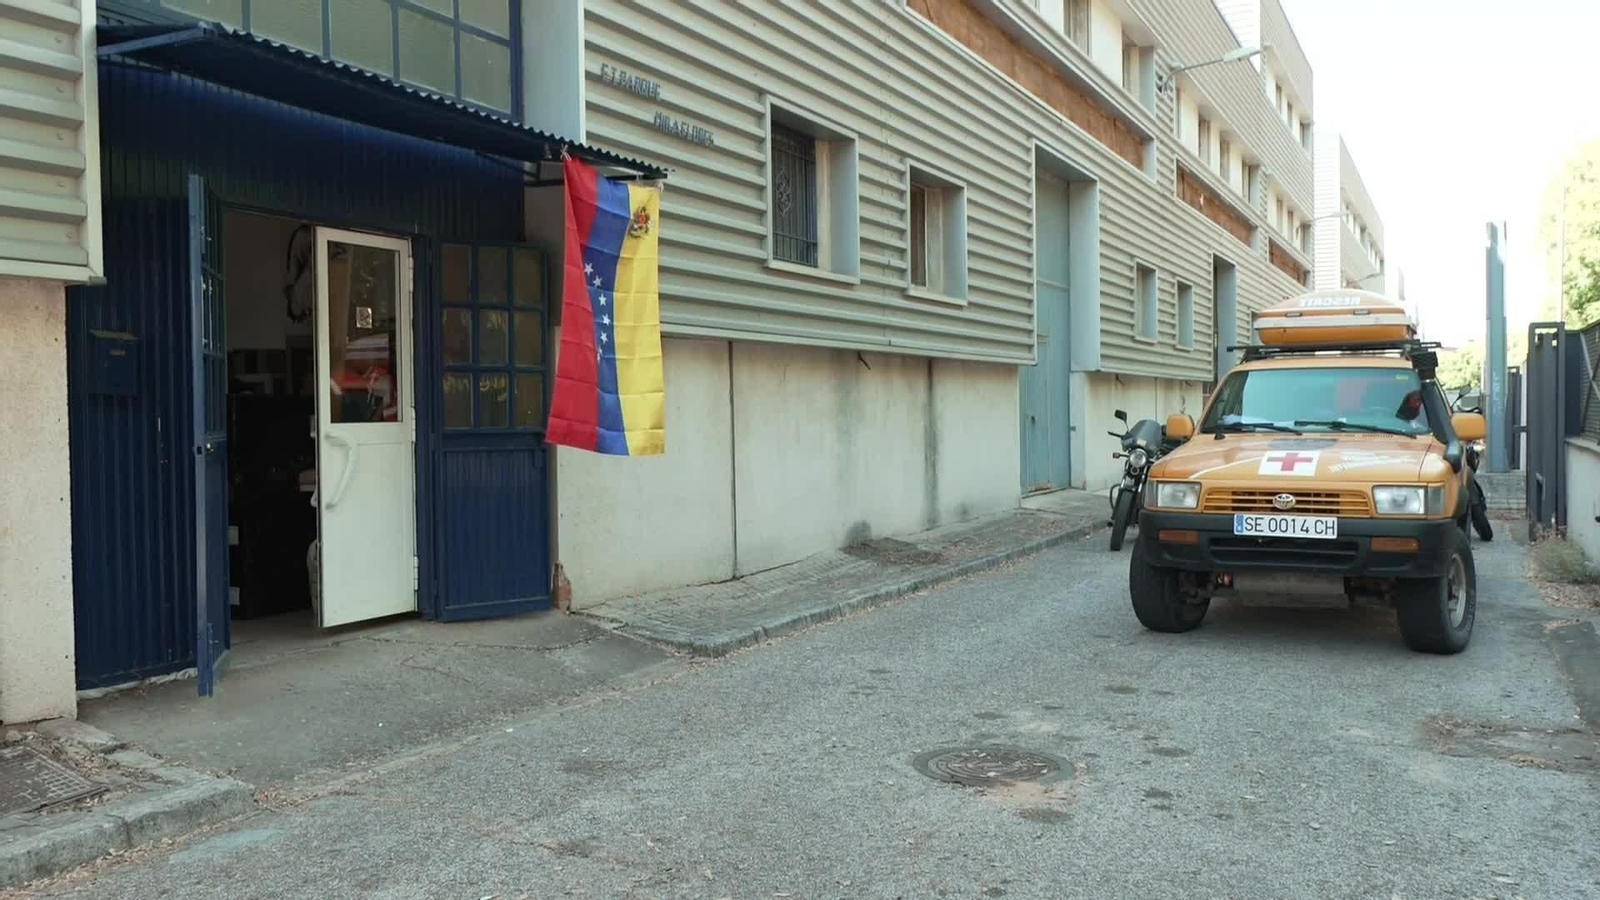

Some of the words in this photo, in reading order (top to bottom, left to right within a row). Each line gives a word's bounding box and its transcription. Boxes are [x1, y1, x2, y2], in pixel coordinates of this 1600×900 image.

[1244, 516, 1264, 533] SE
[1268, 517, 1309, 534] 0014
[1314, 519, 1335, 535] CH
